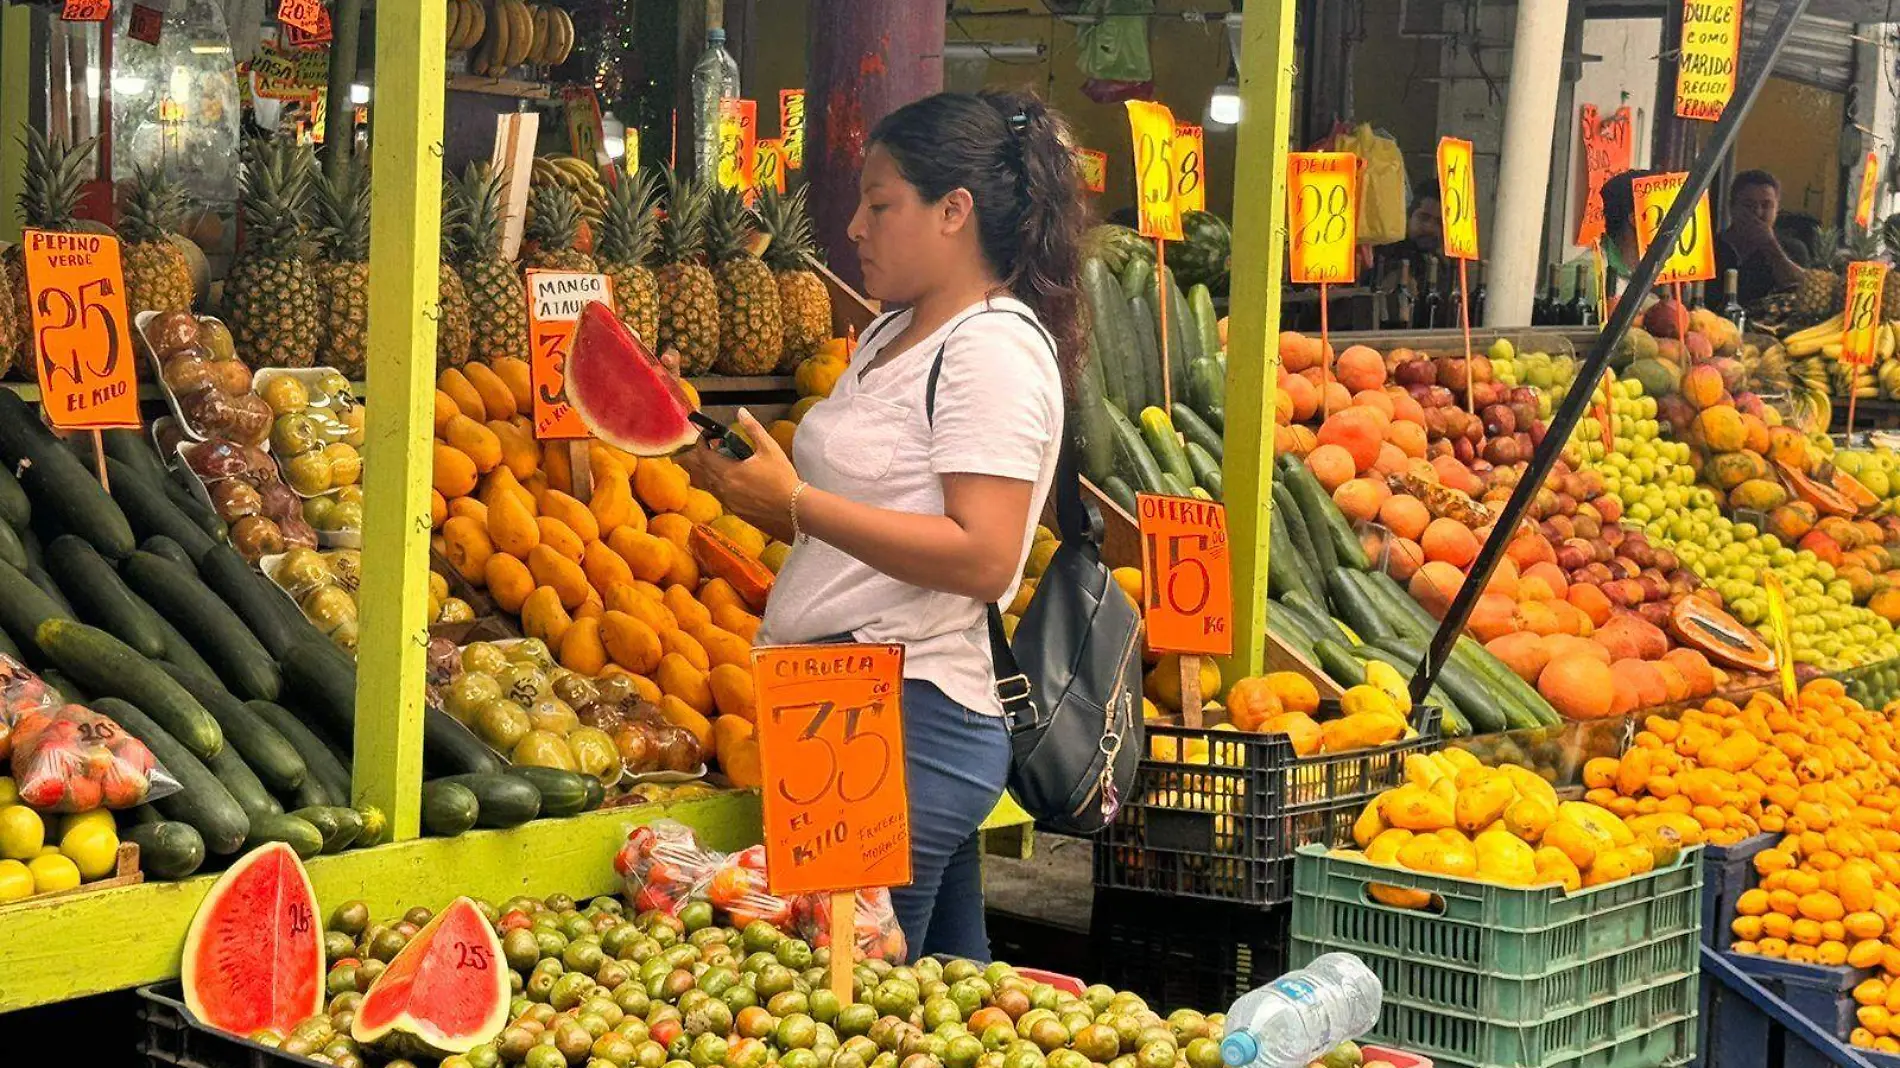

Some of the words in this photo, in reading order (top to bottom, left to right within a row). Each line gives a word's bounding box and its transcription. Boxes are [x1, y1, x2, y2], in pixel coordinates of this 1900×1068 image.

[1684, 3, 1733, 24] DULCE
[1687, 31, 1729, 44] COMO
[1680, 52, 1733, 77] MARIDO
[1683, 80, 1728, 94] RECIEN
[1633, 178, 1684, 199] SORPRE
[1296, 184, 1349, 250] 28
[33, 233, 100, 254] PEPINO
[48, 254, 93, 268] VERDE
[538, 278, 601, 298] MANGO
[1847, 292, 1876, 331] 18
[38, 277, 119, 391] 25
[67, 393, 88, 412] EL
[92, 380, 127, 407] KILO
[539, 418, 552, 433] EL
[1143, 499, 1222, 530] OFERTA
[1146, 533, 1211, 617] 15
[1204, 616, 1225, 635] KG
[775, 656, 874, 678] CIRUELA
[772, 700, 891, 806] 35
[790, 811, 814, 832] EL
